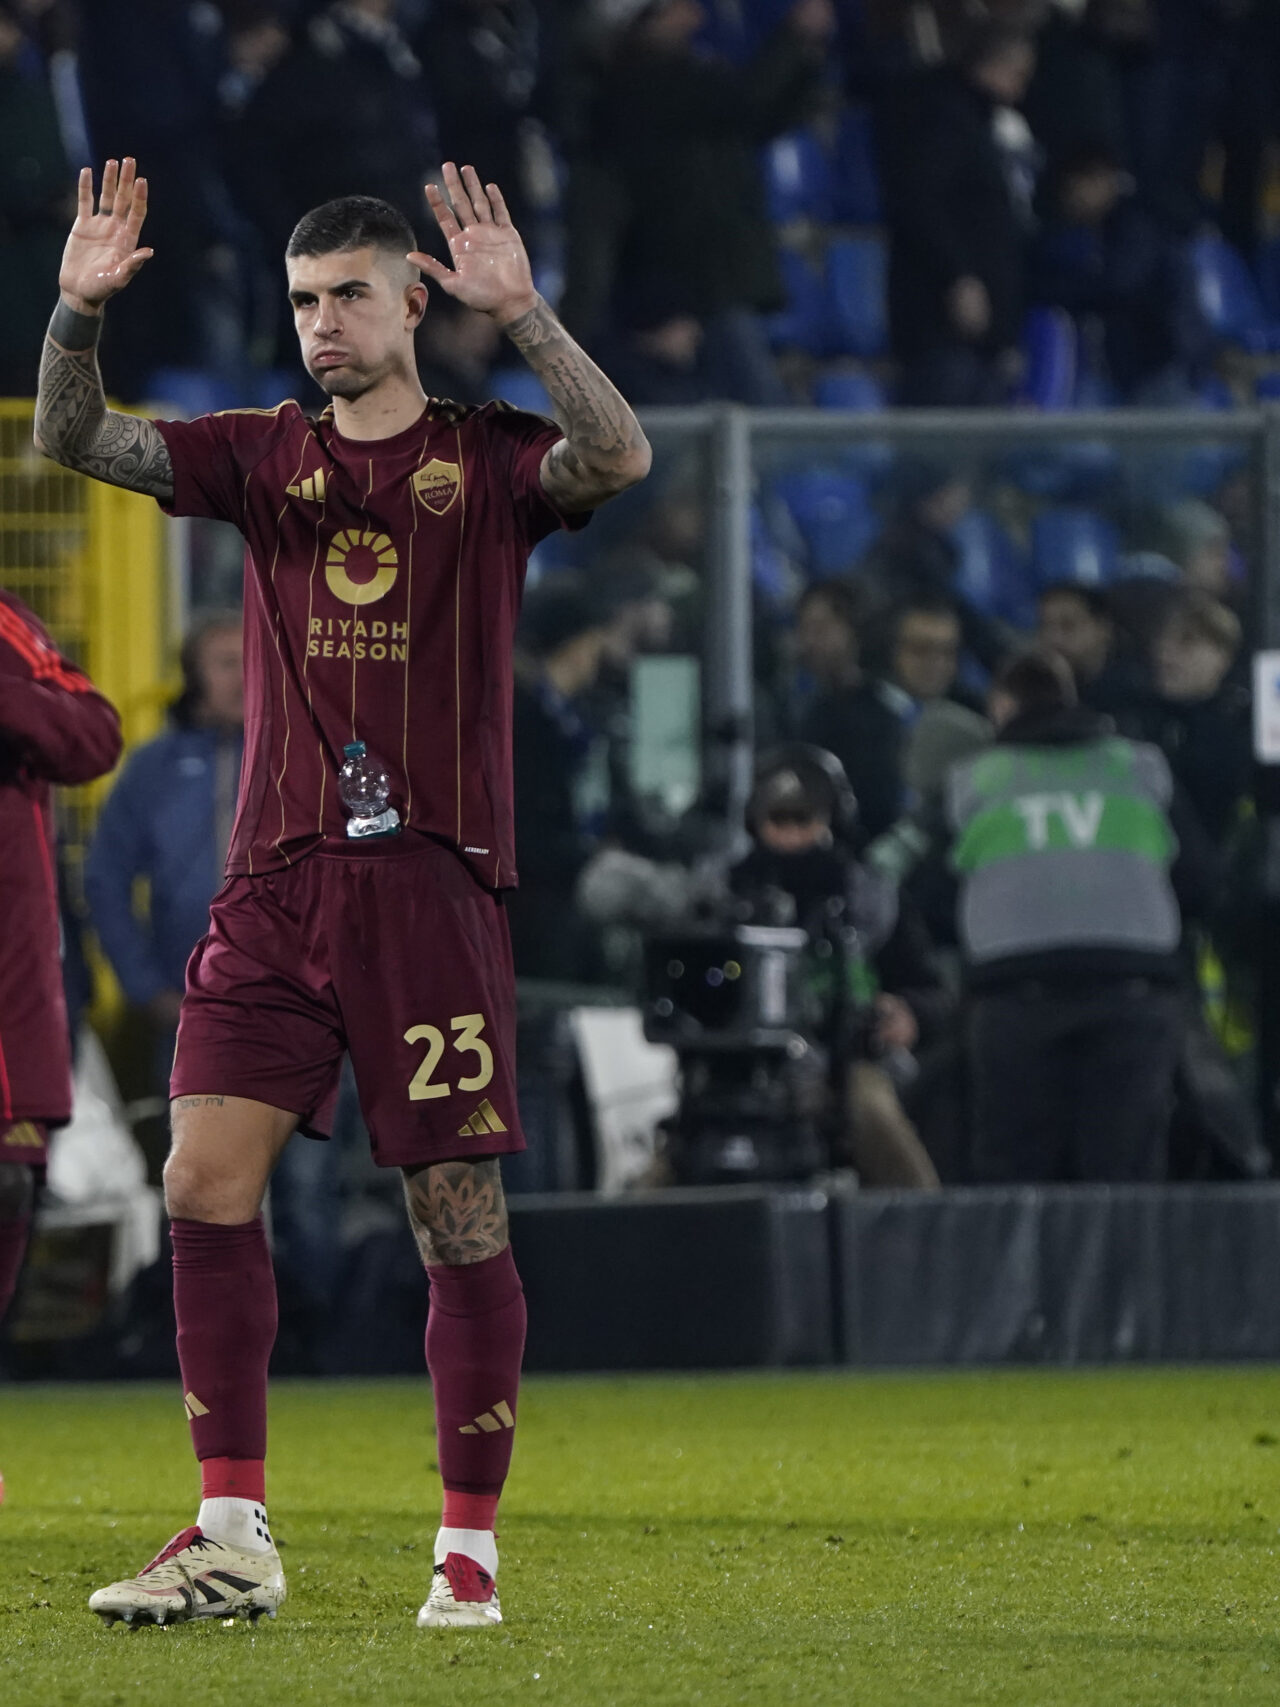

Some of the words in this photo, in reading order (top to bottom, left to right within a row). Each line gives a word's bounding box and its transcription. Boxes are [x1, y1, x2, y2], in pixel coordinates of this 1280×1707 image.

[309, 617, 408, 640] RIYADH
[307, 639, 407, 662] SEASON
[1013, 790, 1104, 851] TV
[402, 1012, 494, 1101] 23
